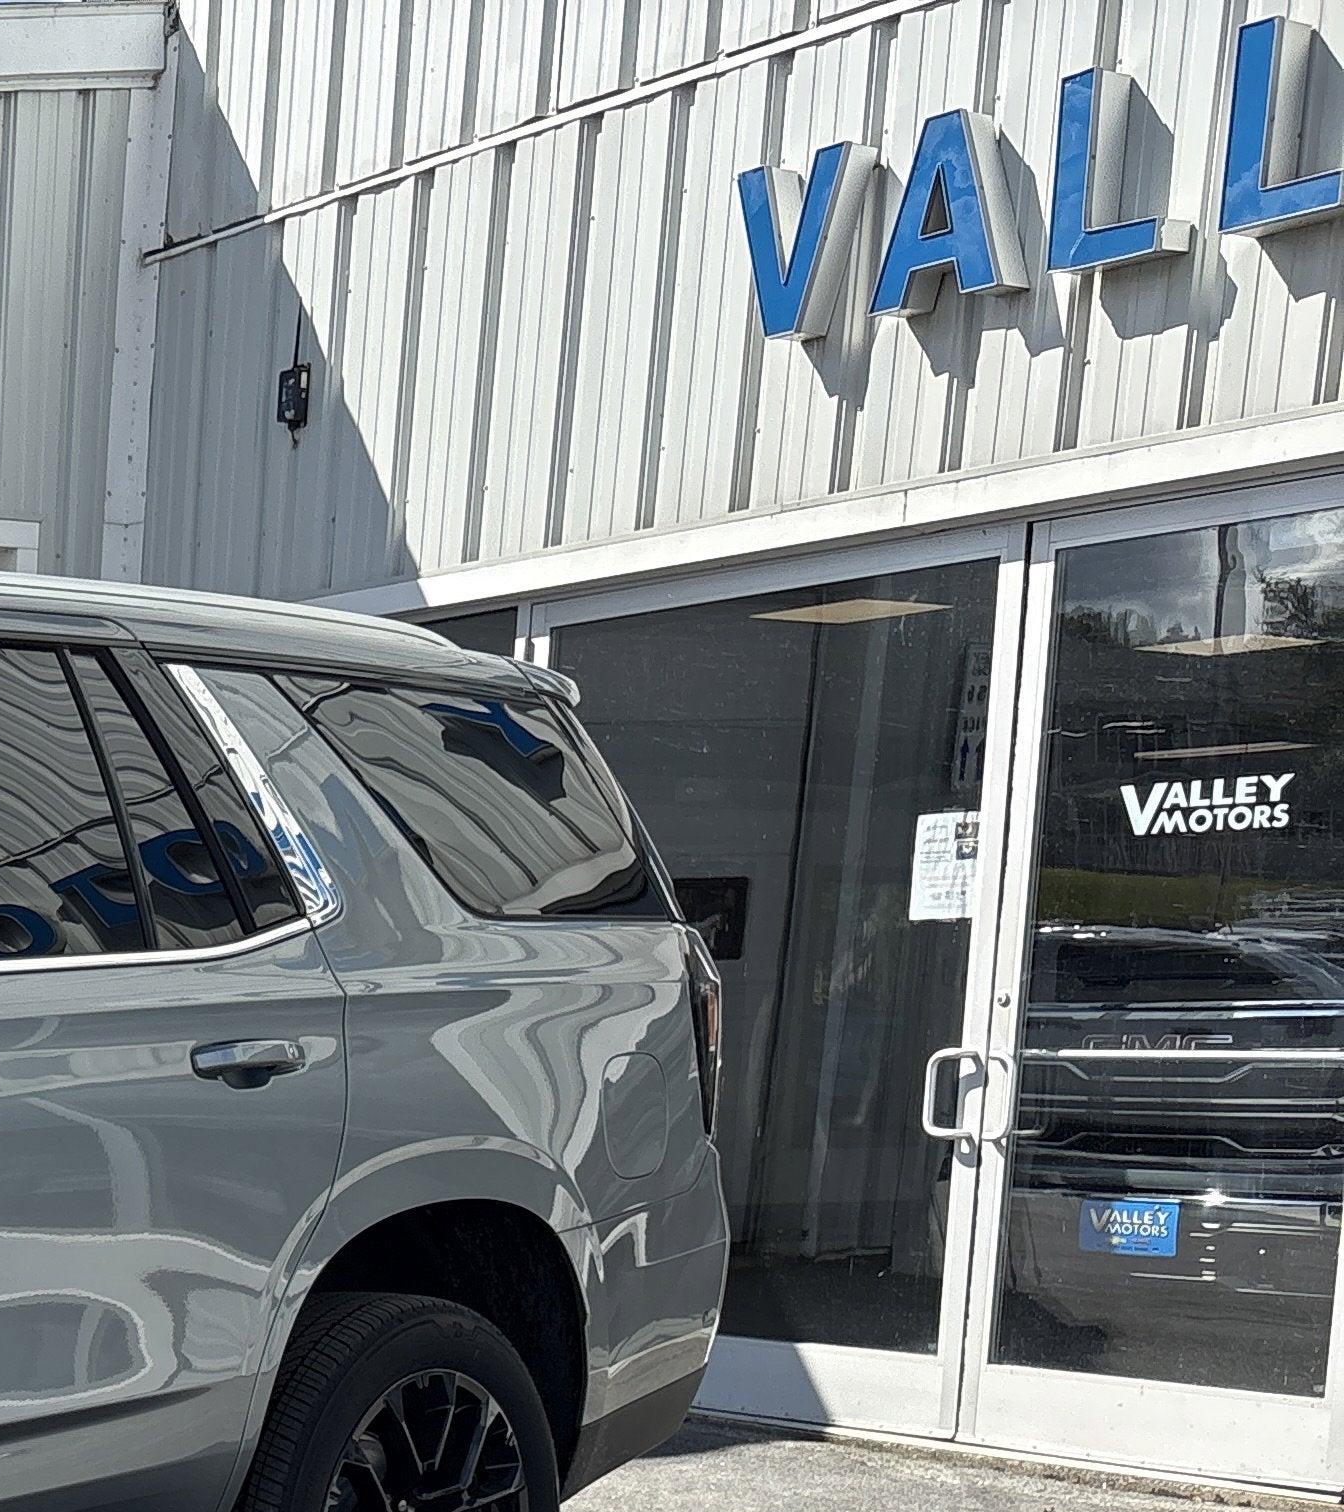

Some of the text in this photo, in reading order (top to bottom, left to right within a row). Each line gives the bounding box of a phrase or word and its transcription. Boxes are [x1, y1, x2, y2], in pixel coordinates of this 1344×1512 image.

[737, 15, 1343, 340] VALL
[1120, 772, 1296, 837] VALLEY
[1150, 803, 1291, 836] MOTORS
[1089, 1207, 1171, 1232] VALLEY
[1104, 1223, 1169, 1238] MOTORS
